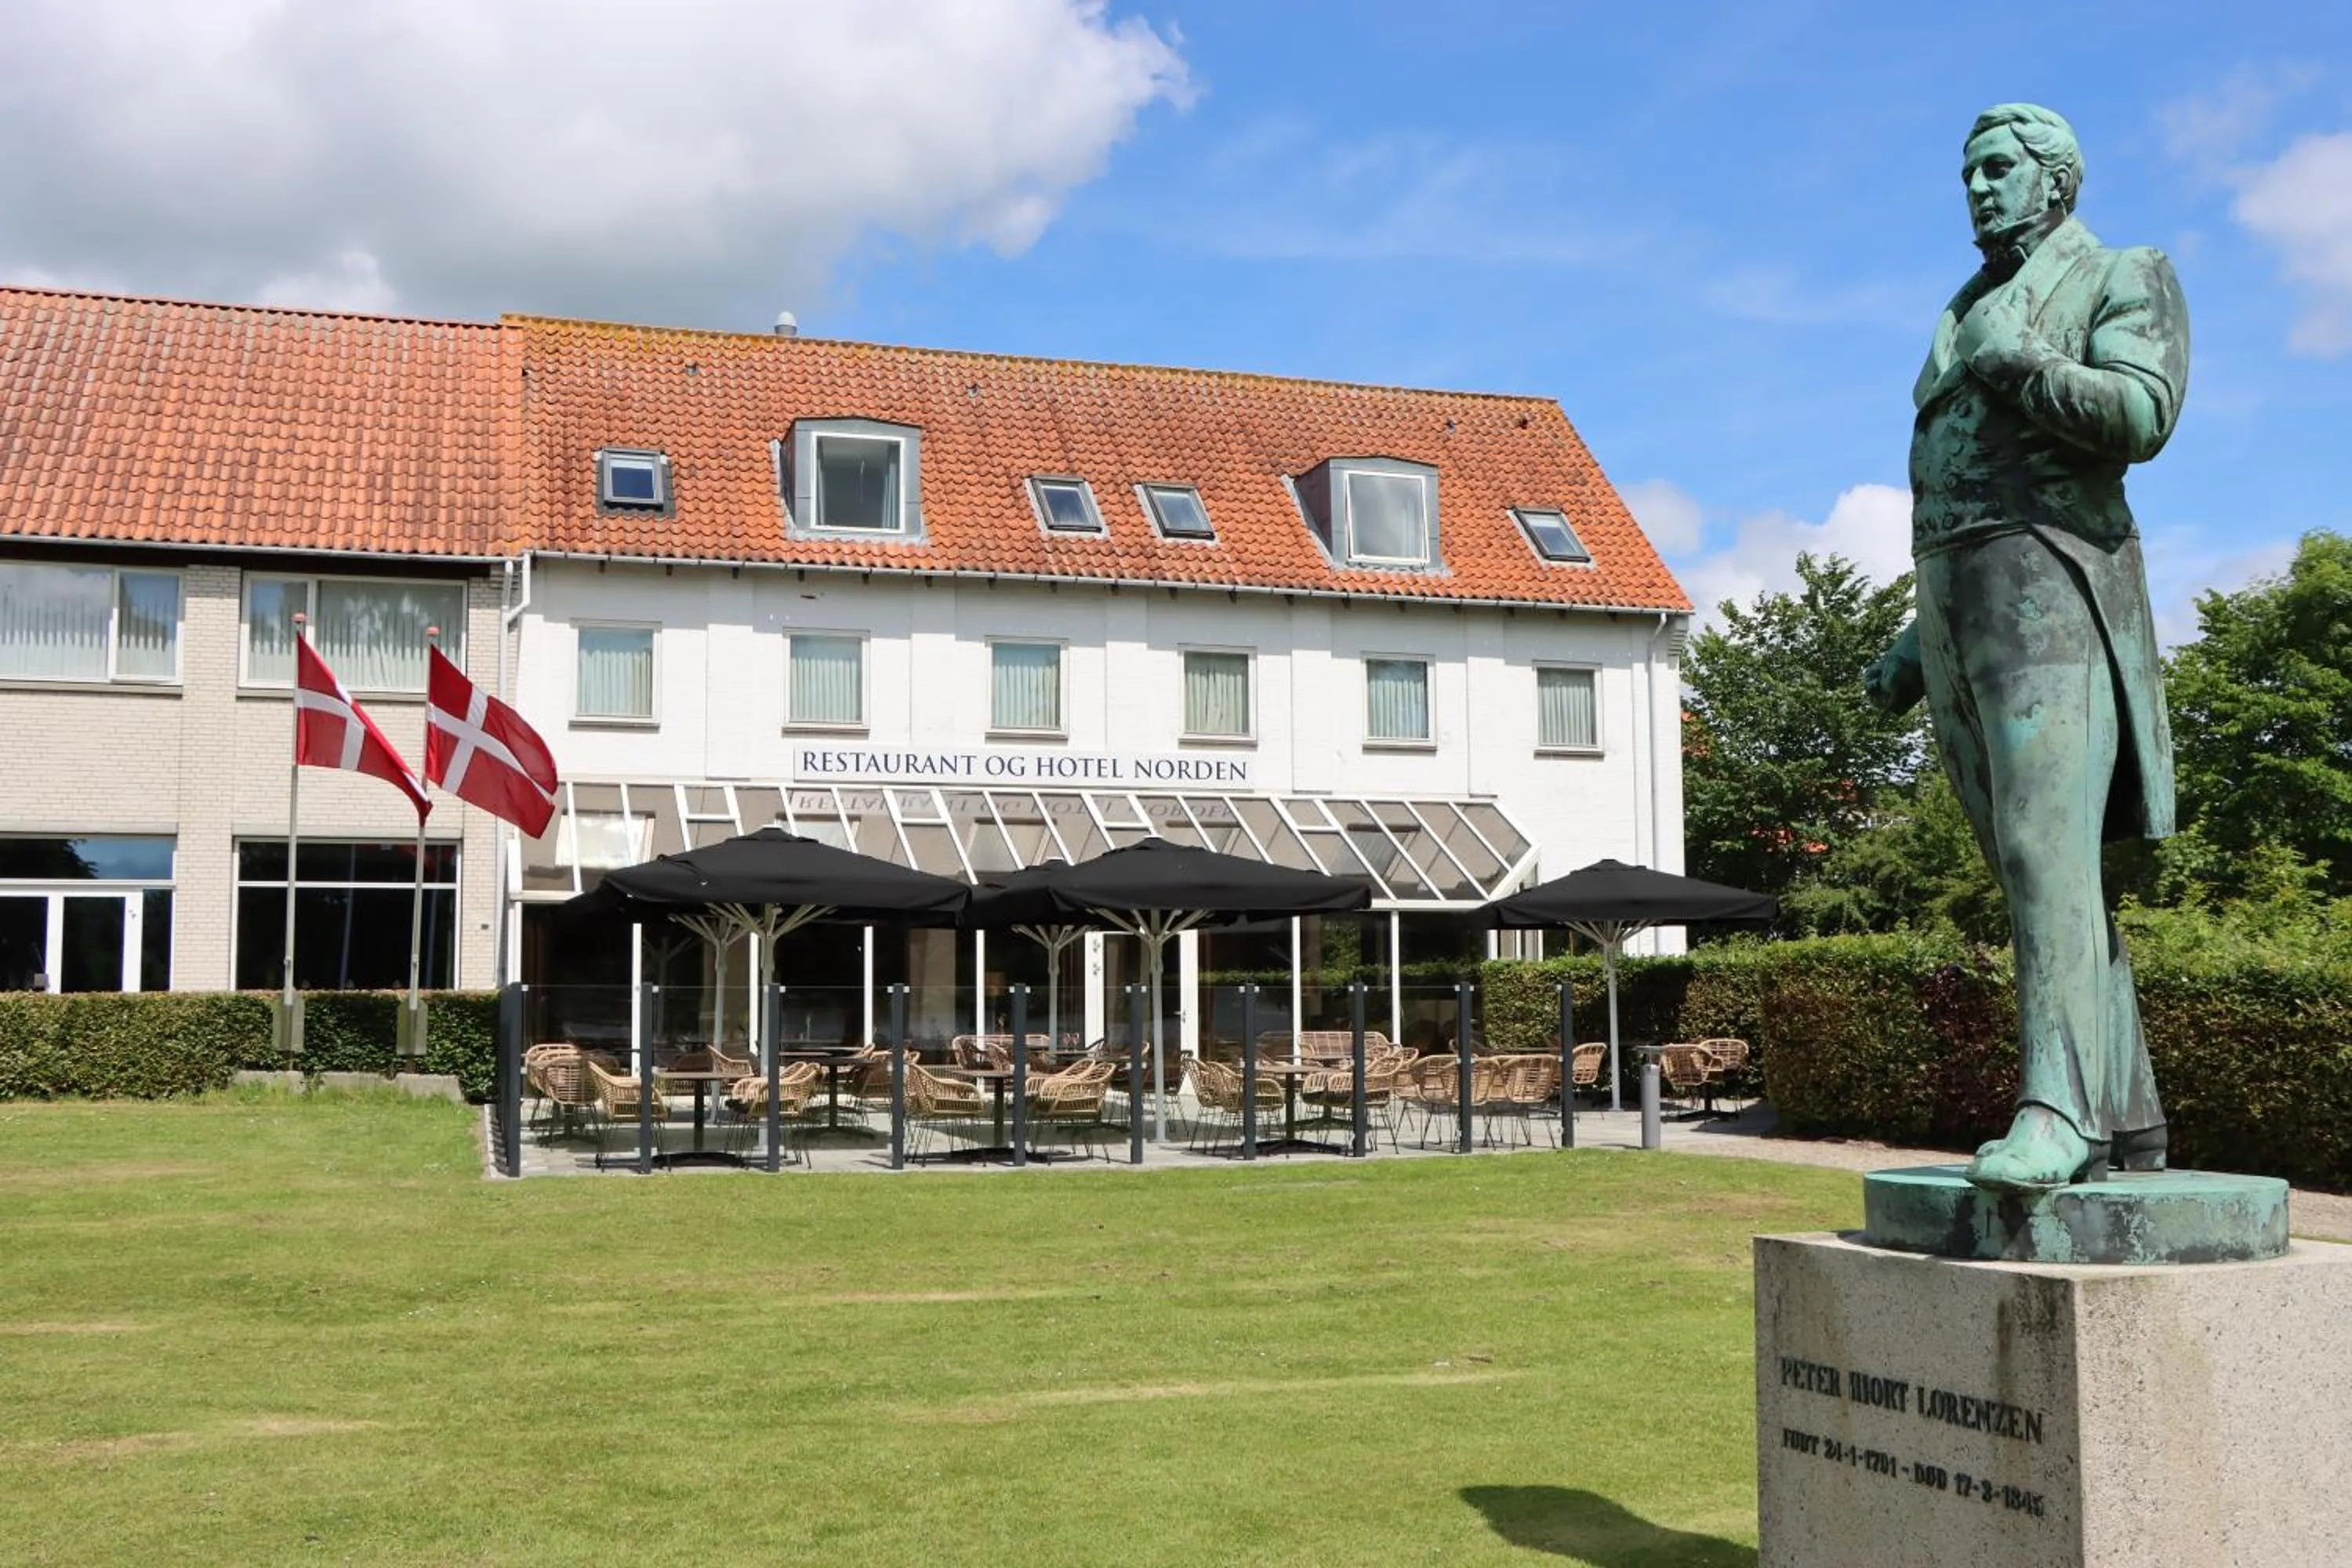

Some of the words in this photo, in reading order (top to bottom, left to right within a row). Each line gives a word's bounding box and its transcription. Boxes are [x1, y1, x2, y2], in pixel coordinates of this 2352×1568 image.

[802, 751, 978, 775] RESTAURANT
[985, 755, 1025, 777] OG
[1036, 756, 1123, 779] HOTEL
[1134, 759, 1247, 782] NORDEN
[1781, 1356, 1842, 1398] PETER
[1849, 1370, 1909, 1414] HIORT
[1917, 1386, 2043, 1445] LORENZEN
